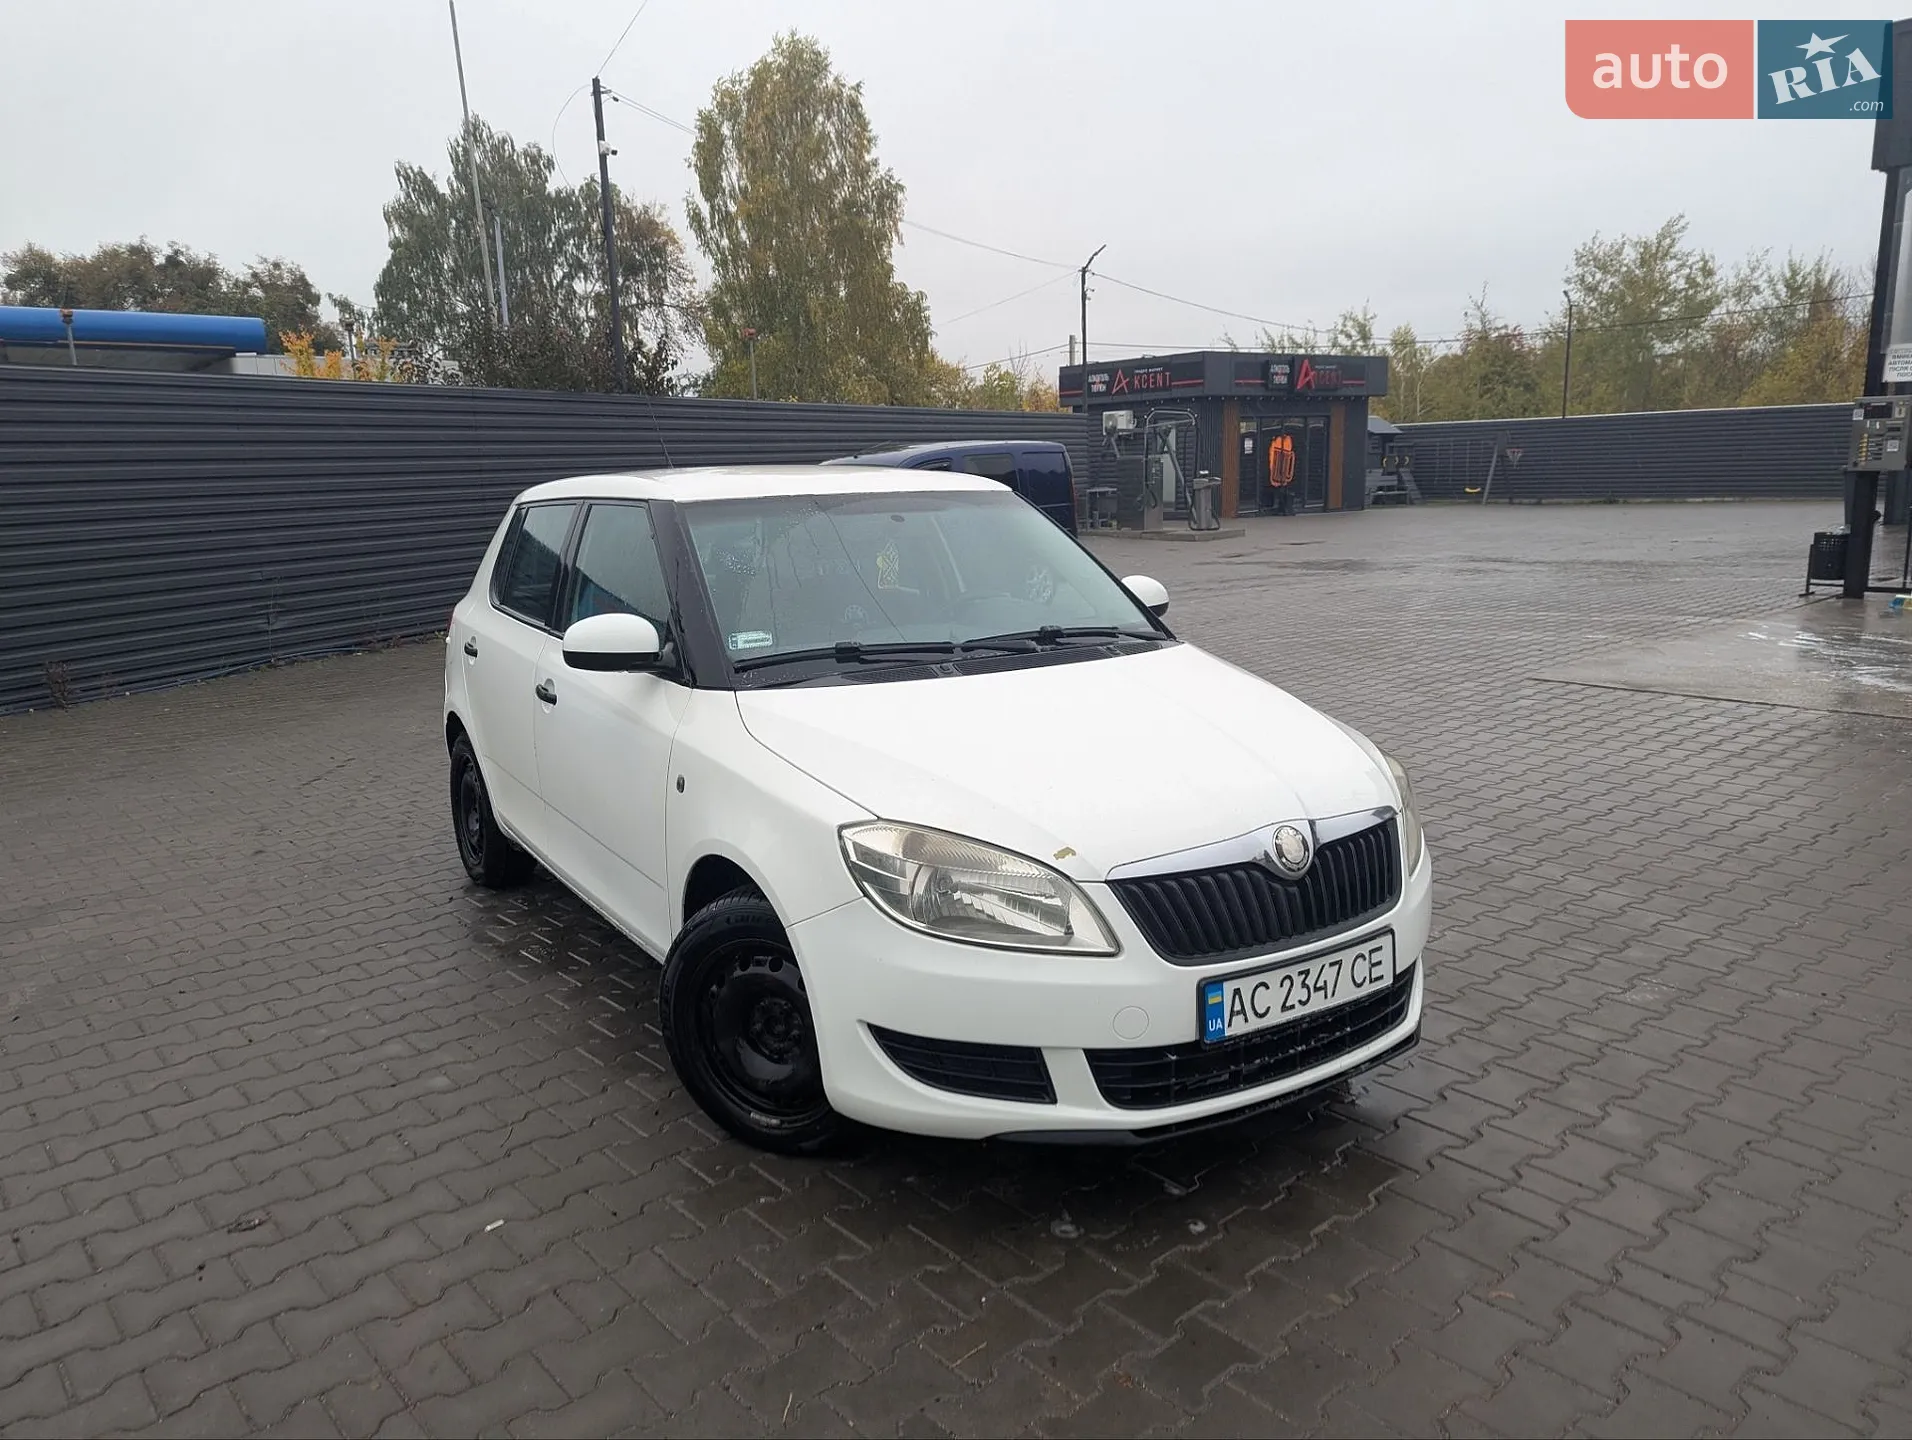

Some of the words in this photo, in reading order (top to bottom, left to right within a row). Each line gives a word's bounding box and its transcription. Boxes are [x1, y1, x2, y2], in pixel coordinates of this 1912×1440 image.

[1227, 981, 1271, 1028] AC
[1279, 958, 1343, 1013] 2347
[1350, 945, 1384, 989] CE
[1208, 1018, 1223, 1032] UA
